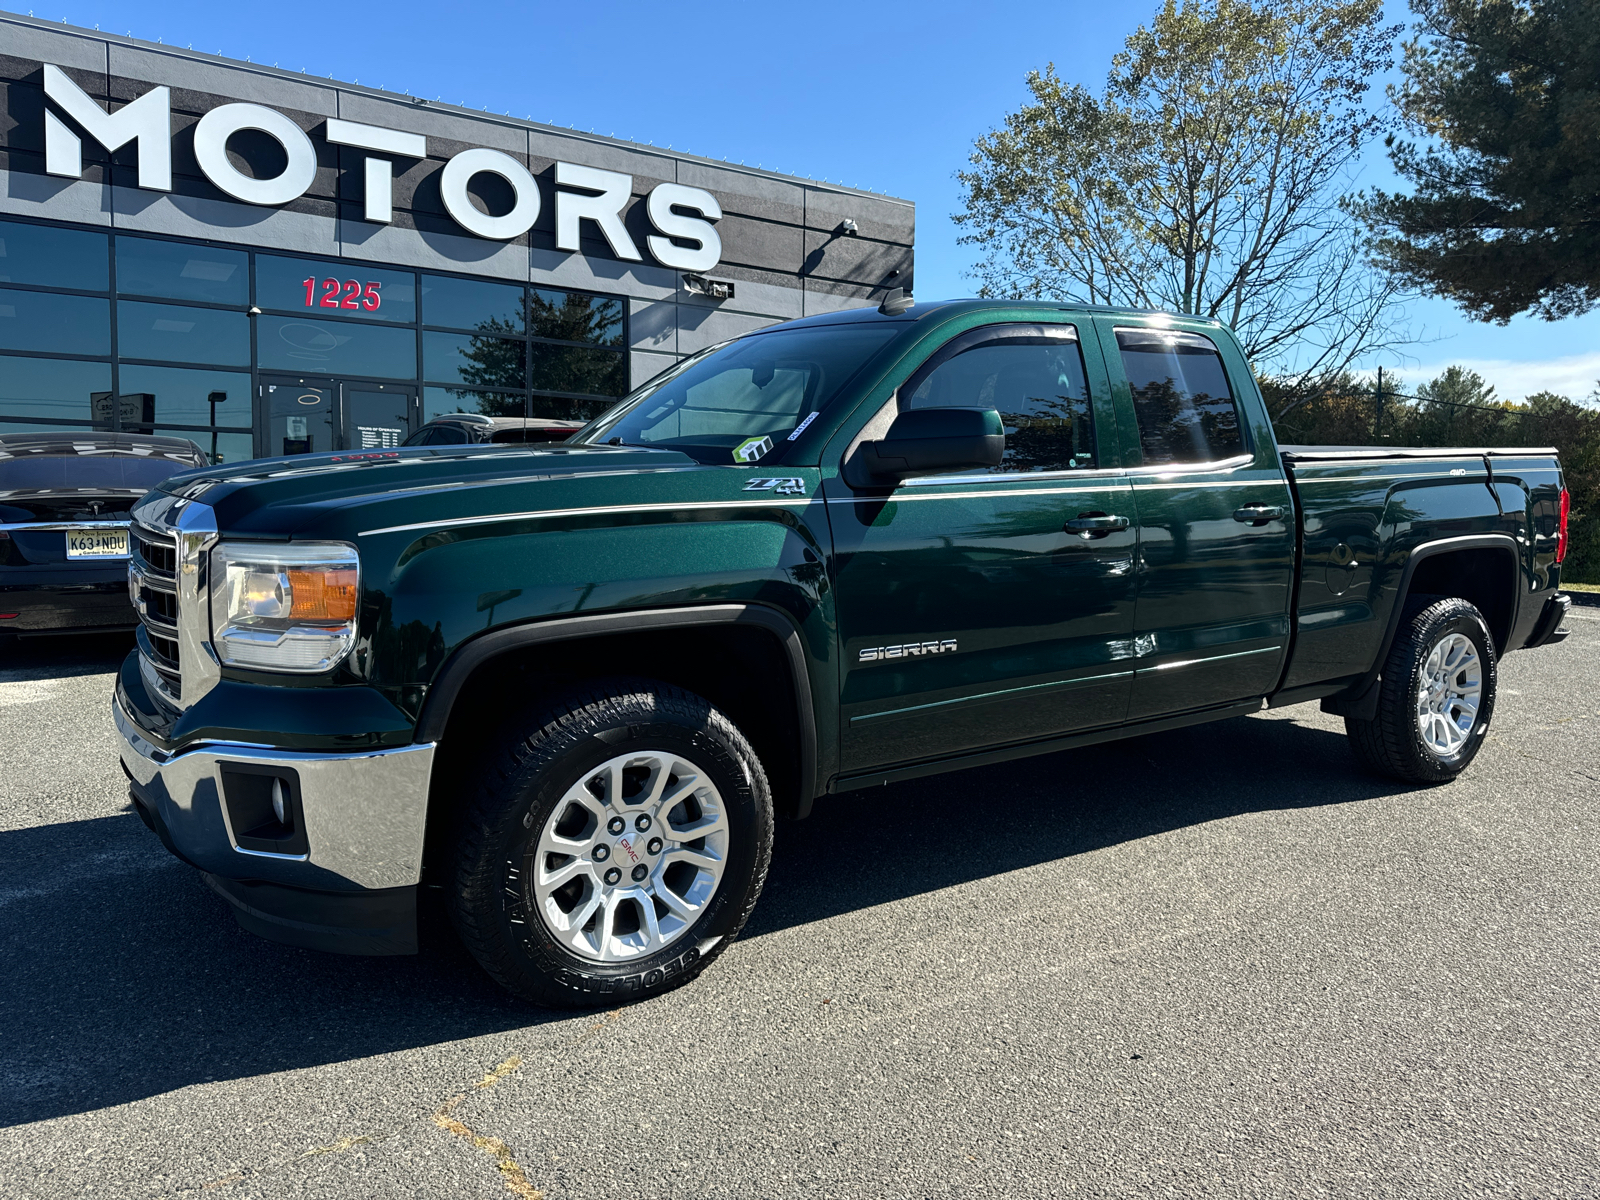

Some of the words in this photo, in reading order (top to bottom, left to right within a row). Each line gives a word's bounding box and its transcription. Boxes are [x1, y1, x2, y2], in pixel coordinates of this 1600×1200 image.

[43, 63, 723, 271] MOTORS
[302, 276, 382, 312] 1225
[70, 537, 94, 551] K63
[101, 536, 125, 550] NDU
[859, 639, 957, 662] SIERRA
[621, 838, 639, 863] GMC
